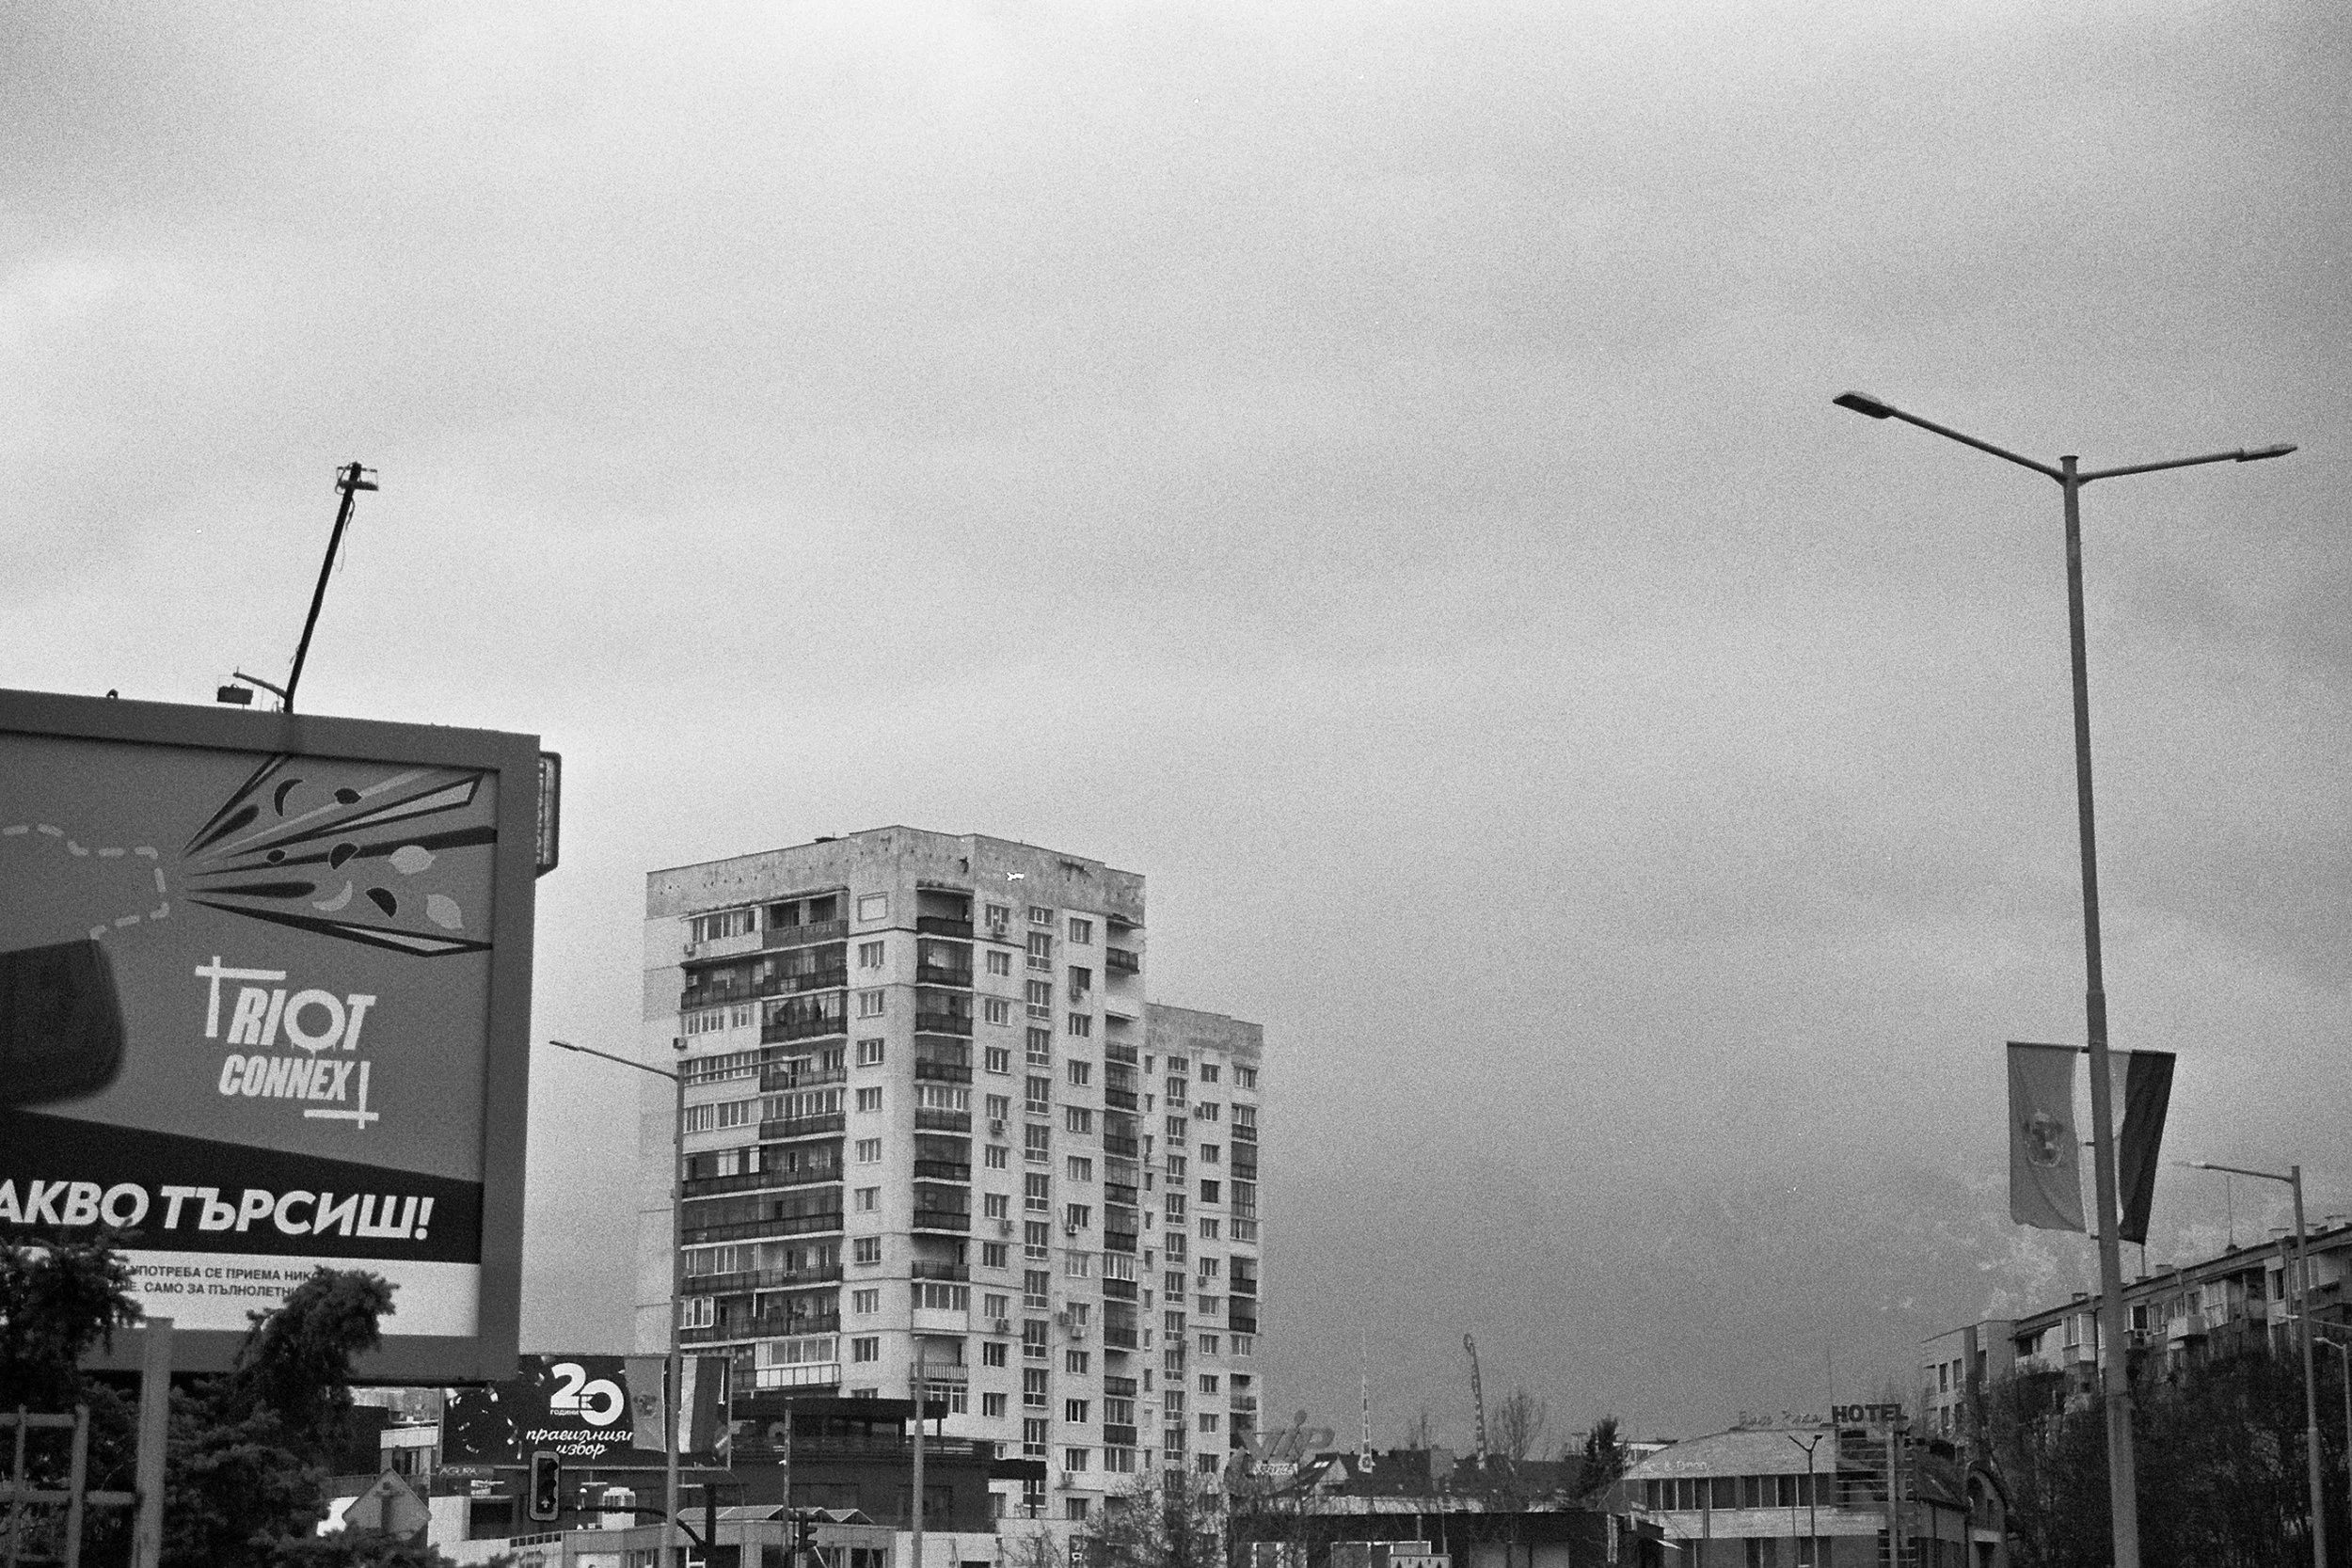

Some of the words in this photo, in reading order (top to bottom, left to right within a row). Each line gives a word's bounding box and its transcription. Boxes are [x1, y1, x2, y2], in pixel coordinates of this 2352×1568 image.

[218, 1053, 356, 1101] CONNEX
[161, 1184, 436, 1241] ТЪРСИШ!
[204, 1267, 223, 1279] СЕ
[226, 1268, 281, 1280] ПРИЕМА
[284, 1270, 321, 1281] НИКО
[144, 1281, 184, 1294] САМО
[187, 1283, 205, 1295] ЗА
[549, 1362, 625, 1427] 20
[1832, 1403, 1909, 1422] HOTEL
[556, 1439, 609, 1460] избор
